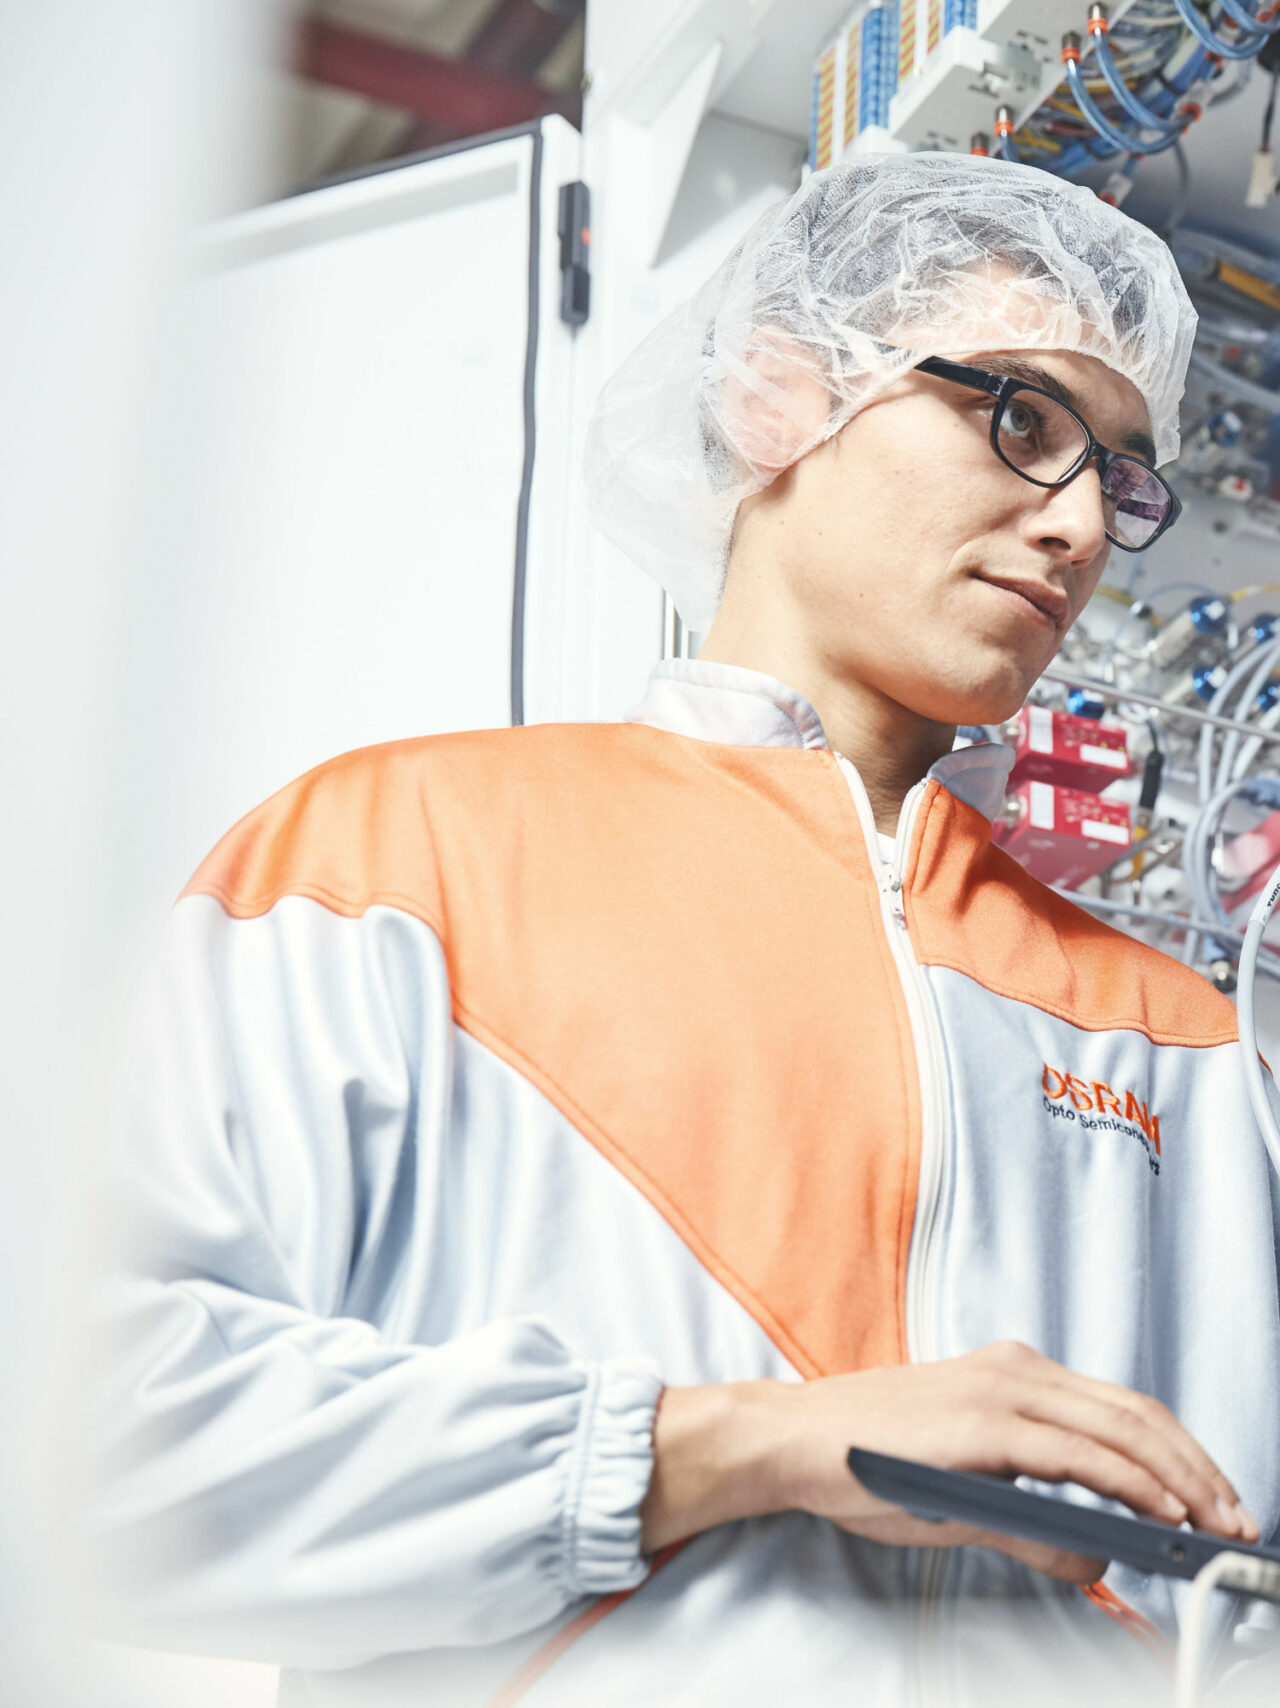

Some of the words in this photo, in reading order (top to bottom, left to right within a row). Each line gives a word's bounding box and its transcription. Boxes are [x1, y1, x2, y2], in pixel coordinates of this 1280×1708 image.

[1042, 1063, 1161, 1156] OSRAM
[1043, 1095, 1076, 1120] Opto
[1079, 1113, 1160, 1176] Semiconrs
